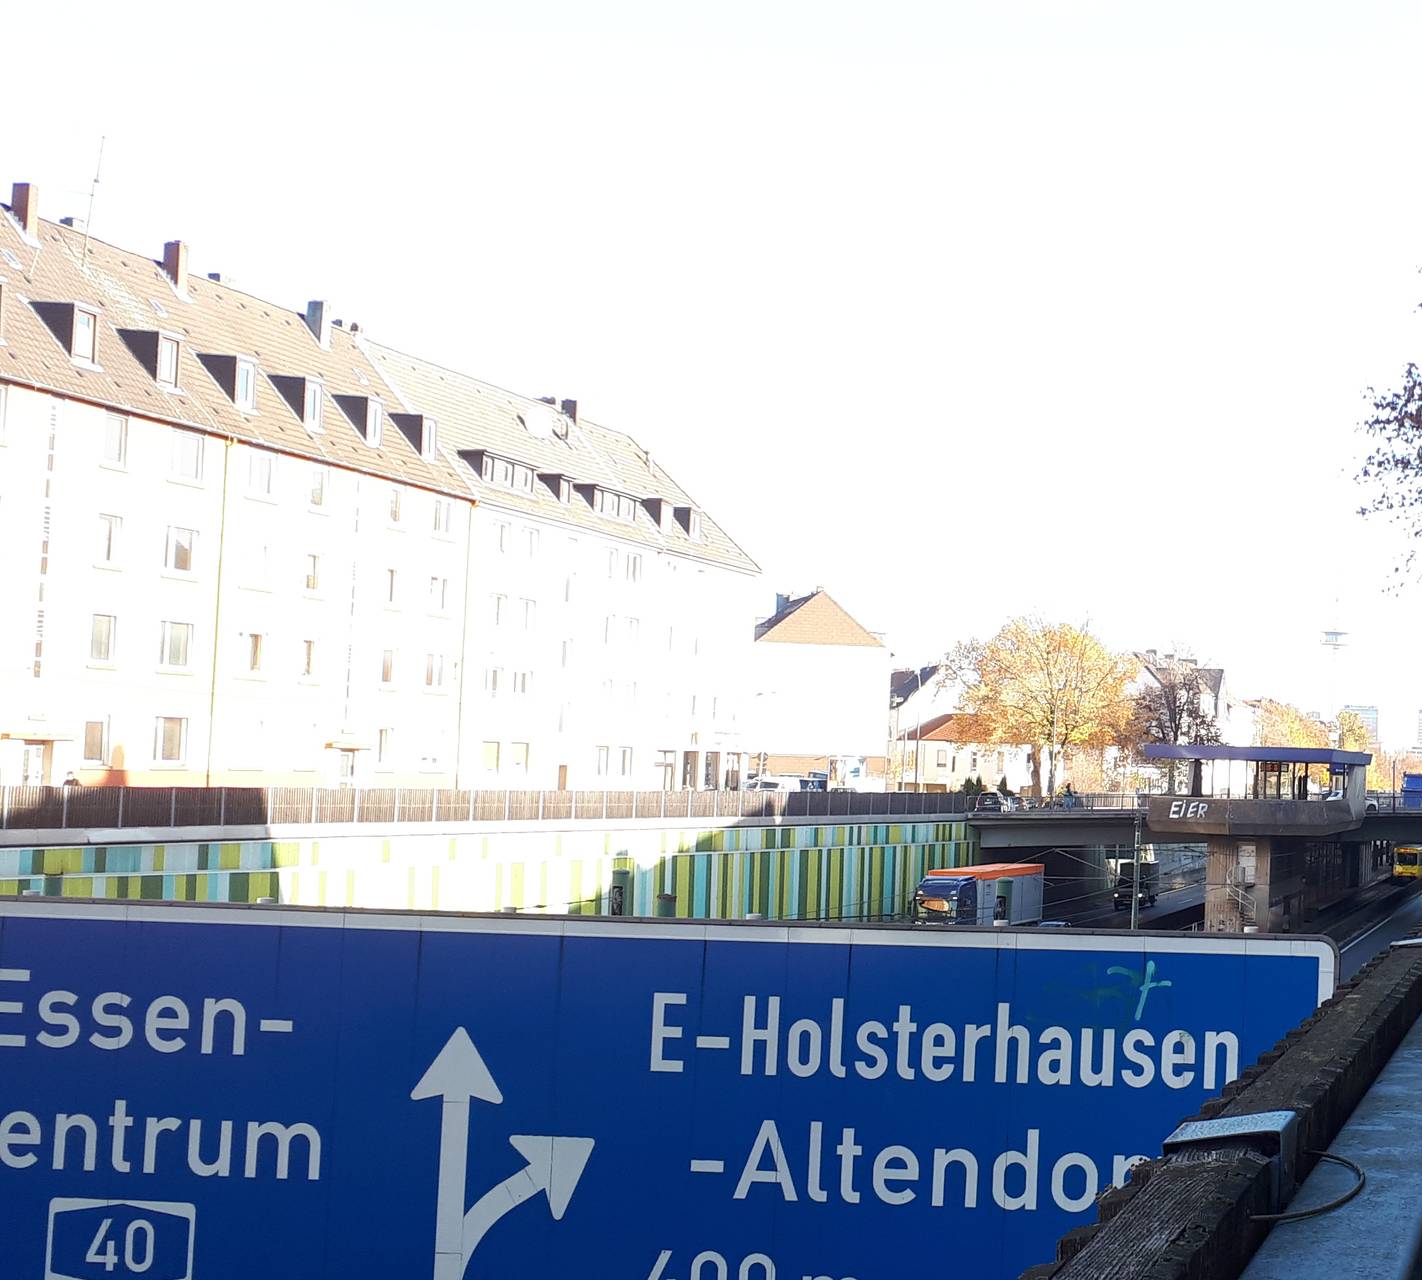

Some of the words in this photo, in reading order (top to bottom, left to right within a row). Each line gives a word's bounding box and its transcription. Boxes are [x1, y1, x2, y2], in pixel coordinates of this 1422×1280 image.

[0, 968, 293, 1055] Essen-
[650, 992, 1239, 1090] E-Holsterhausen
[0, 1099, 321, 1180] entrum
[690, 1119, 1162, 1213] -Altendor
[85, 1218, 155, 1273] 40
